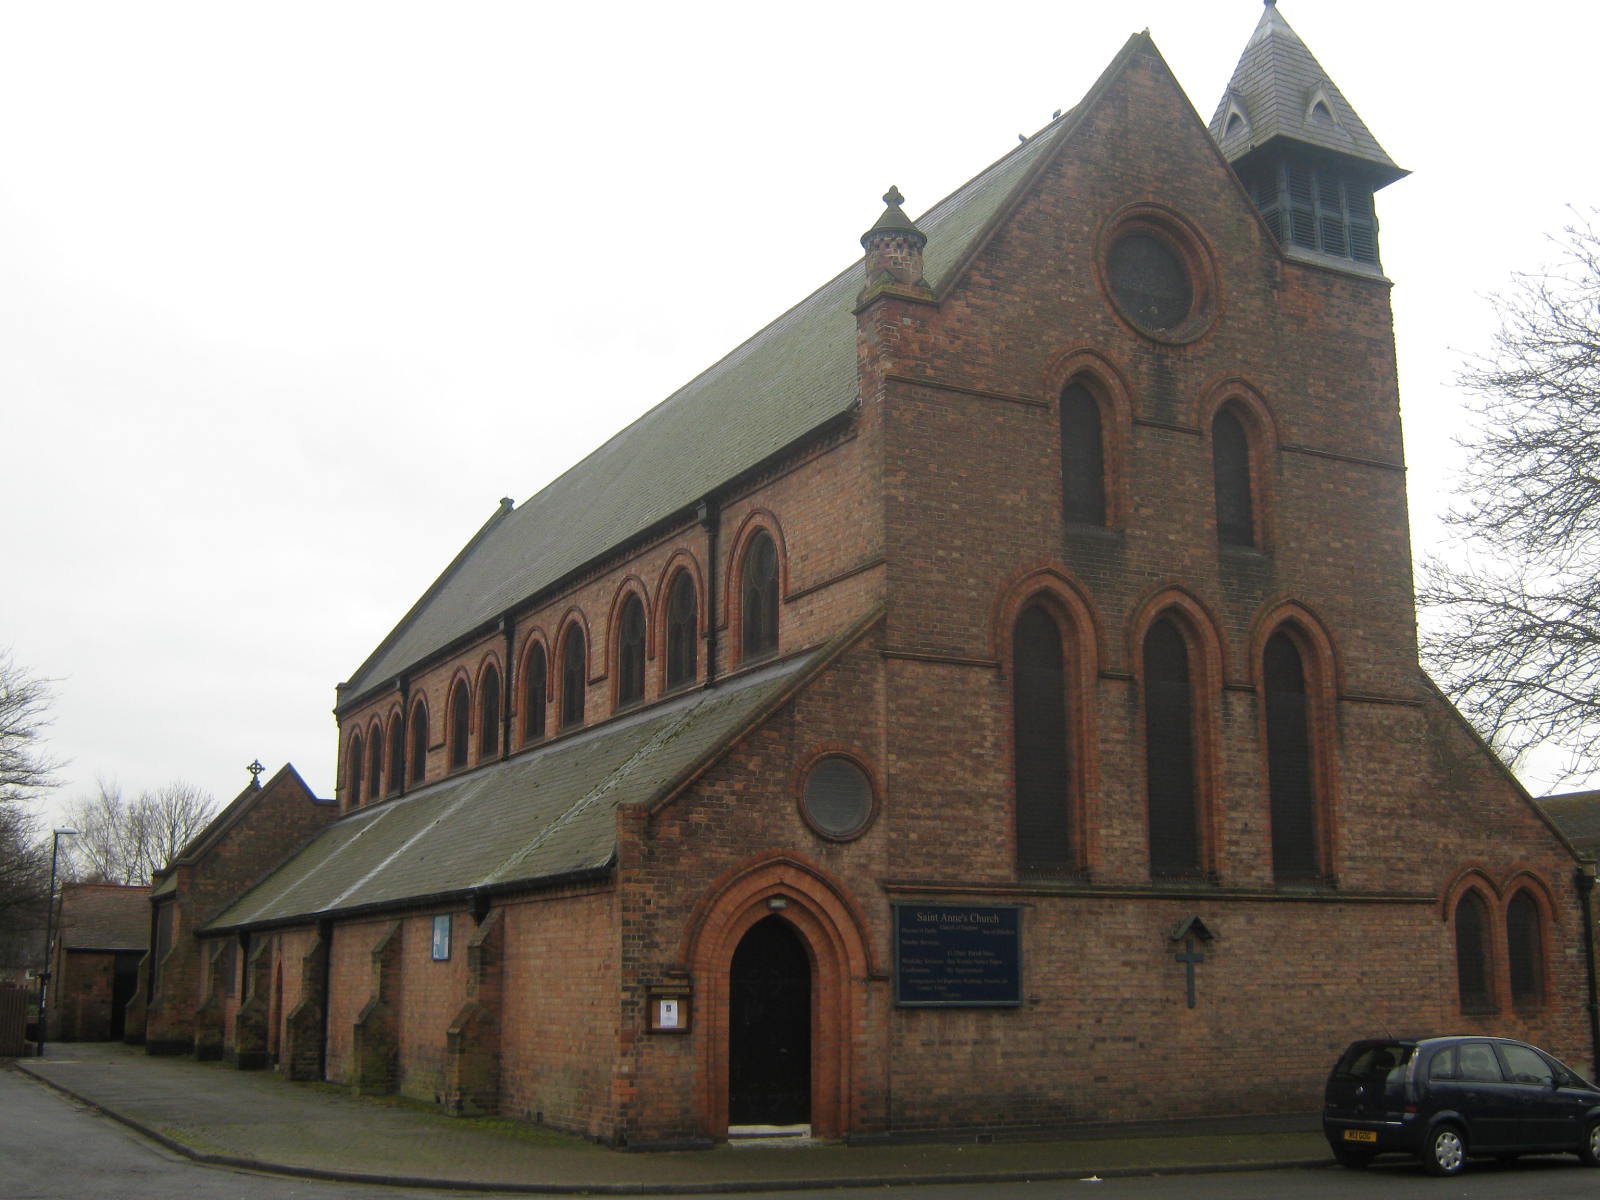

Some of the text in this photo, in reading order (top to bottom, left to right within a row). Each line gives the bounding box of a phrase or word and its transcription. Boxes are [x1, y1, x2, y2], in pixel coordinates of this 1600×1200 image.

[916, 911, 999, 924] Saint Anne's Church
